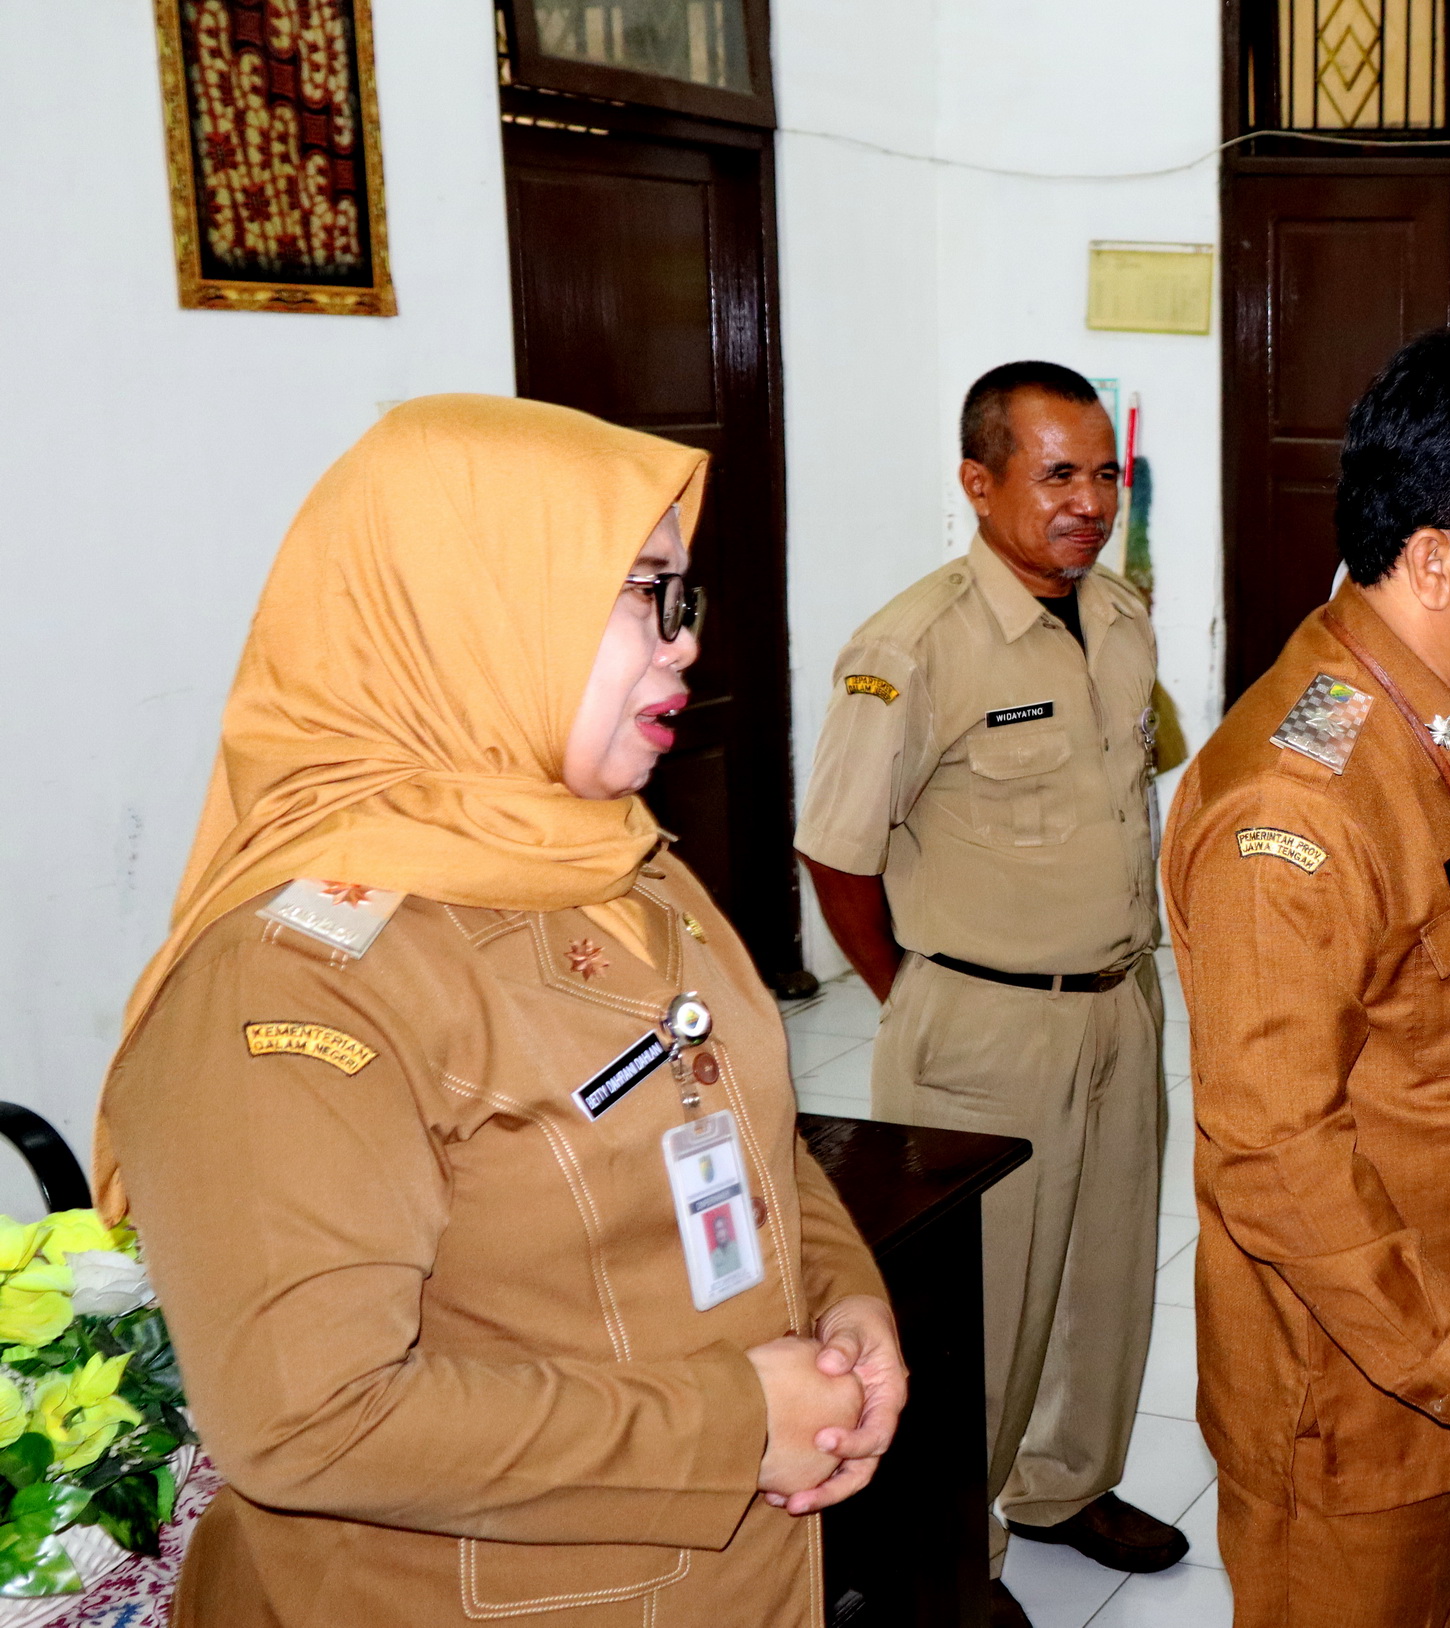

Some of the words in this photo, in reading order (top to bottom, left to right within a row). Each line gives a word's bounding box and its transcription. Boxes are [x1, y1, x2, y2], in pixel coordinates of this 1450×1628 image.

[995, 707, 1044, 722] WIDAYATNO
[1239, 831, 1295, 846] PEMERINTAH
[1296, 840, 1323, 862] PROV.
[1243, 842, 1272, 853] JAWA
[1277, 844, 1315, 869] TENGAH
[252, 1025, 370, 1060] KEMENTERIAN
[254, 1040, 308, 1051] DALAM
[313, 1042, 359, 1071] NEGERI
[585, 1084, 611, 1111] BETTY
[605, 1061, 640, 1094] DAHRANI
[633, 1041, 665, 1071] DAHLAN
